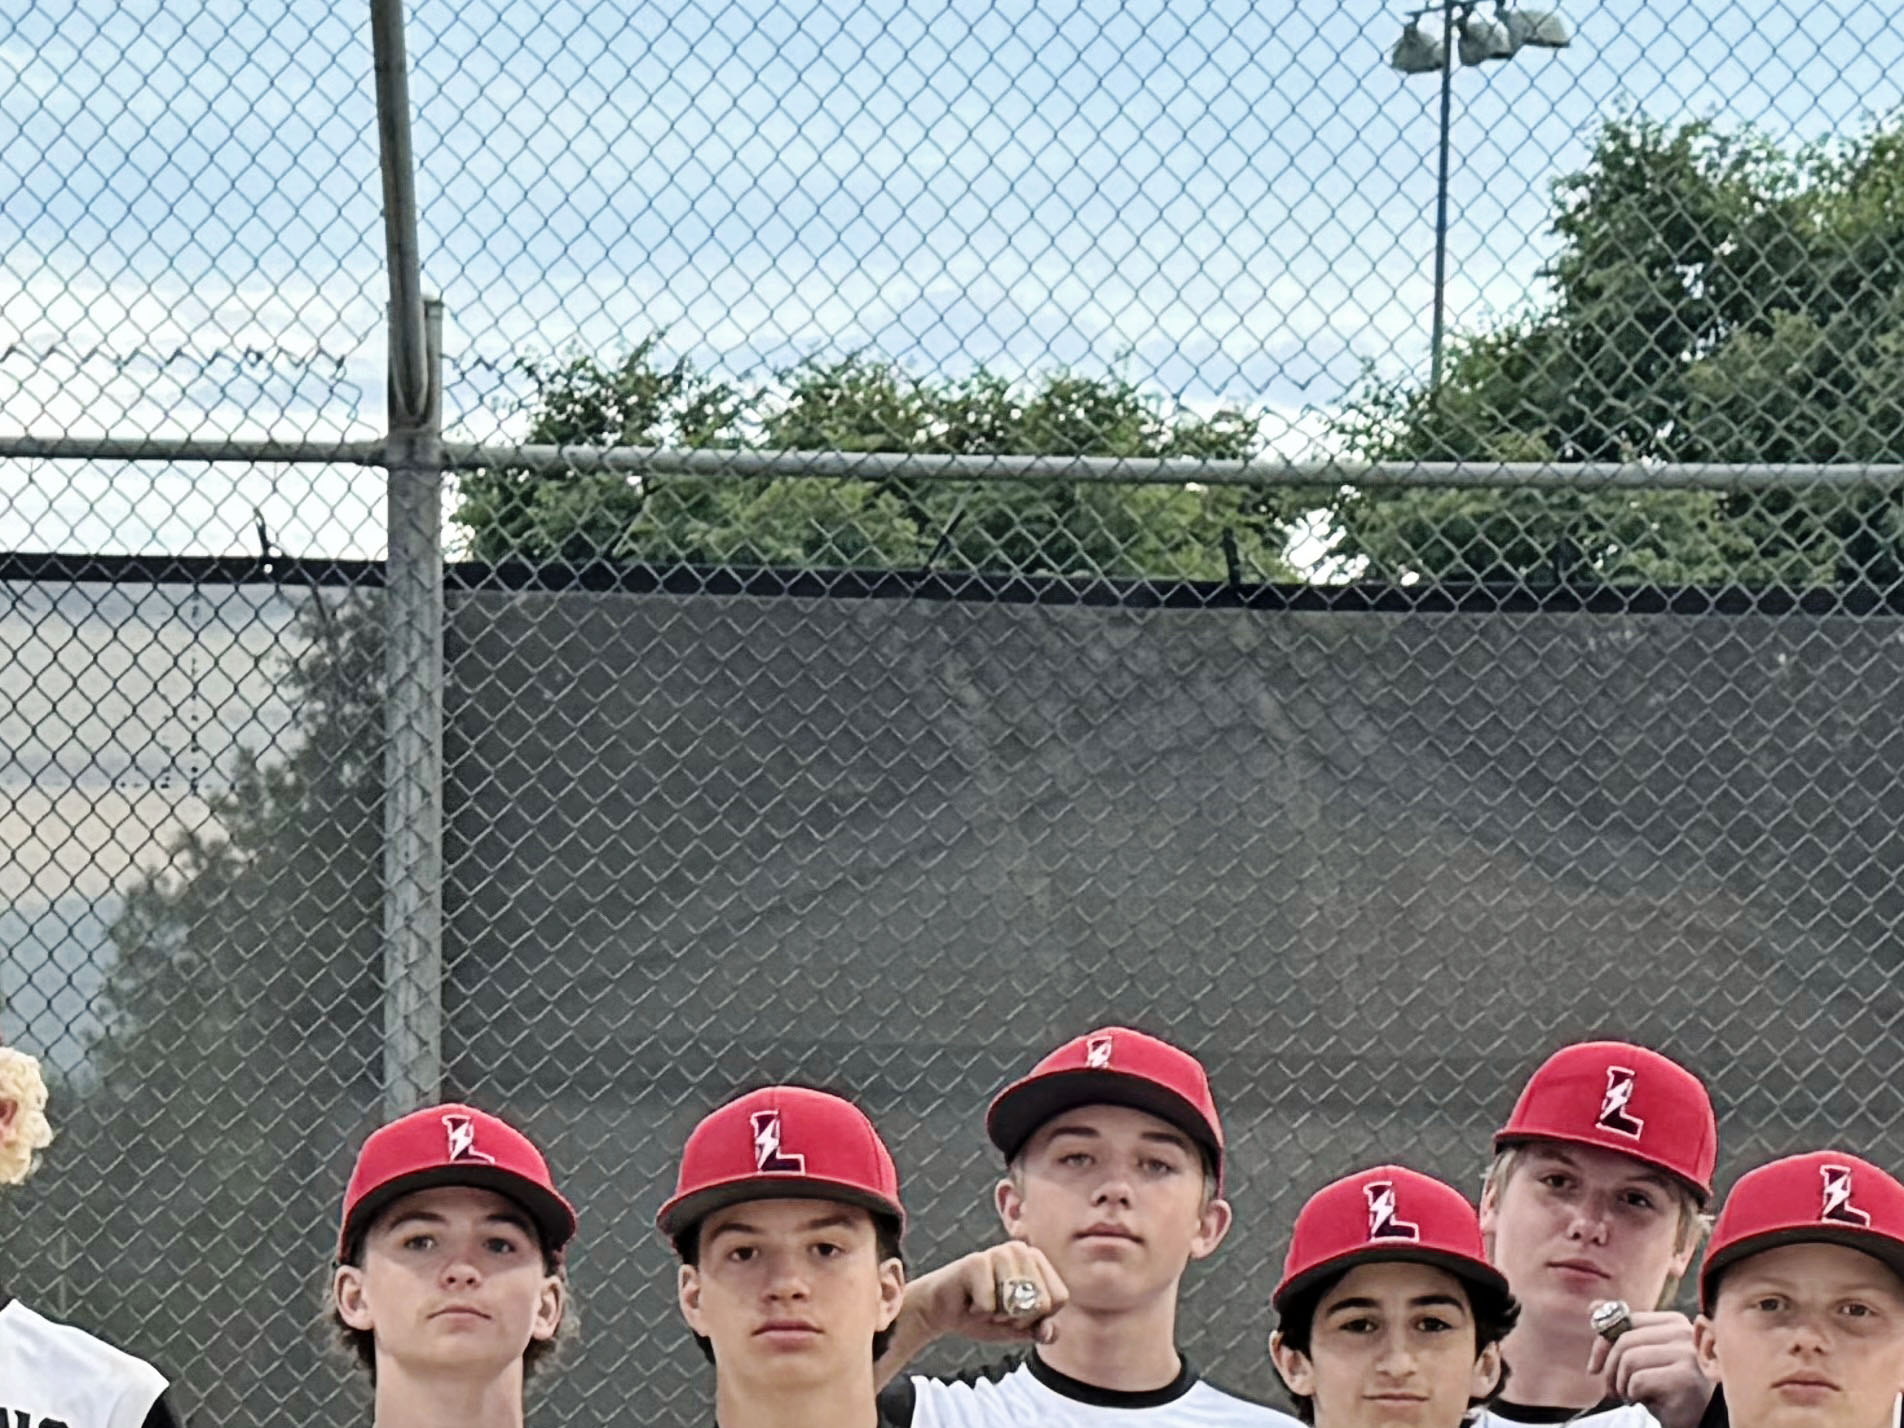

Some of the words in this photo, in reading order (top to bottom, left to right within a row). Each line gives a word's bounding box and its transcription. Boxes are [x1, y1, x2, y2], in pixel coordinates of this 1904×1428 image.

[1596, 1066, 1643, 1141] L
[751, 1110, 805, 1175] L
[1362, 1181, 1420, 1243] L
